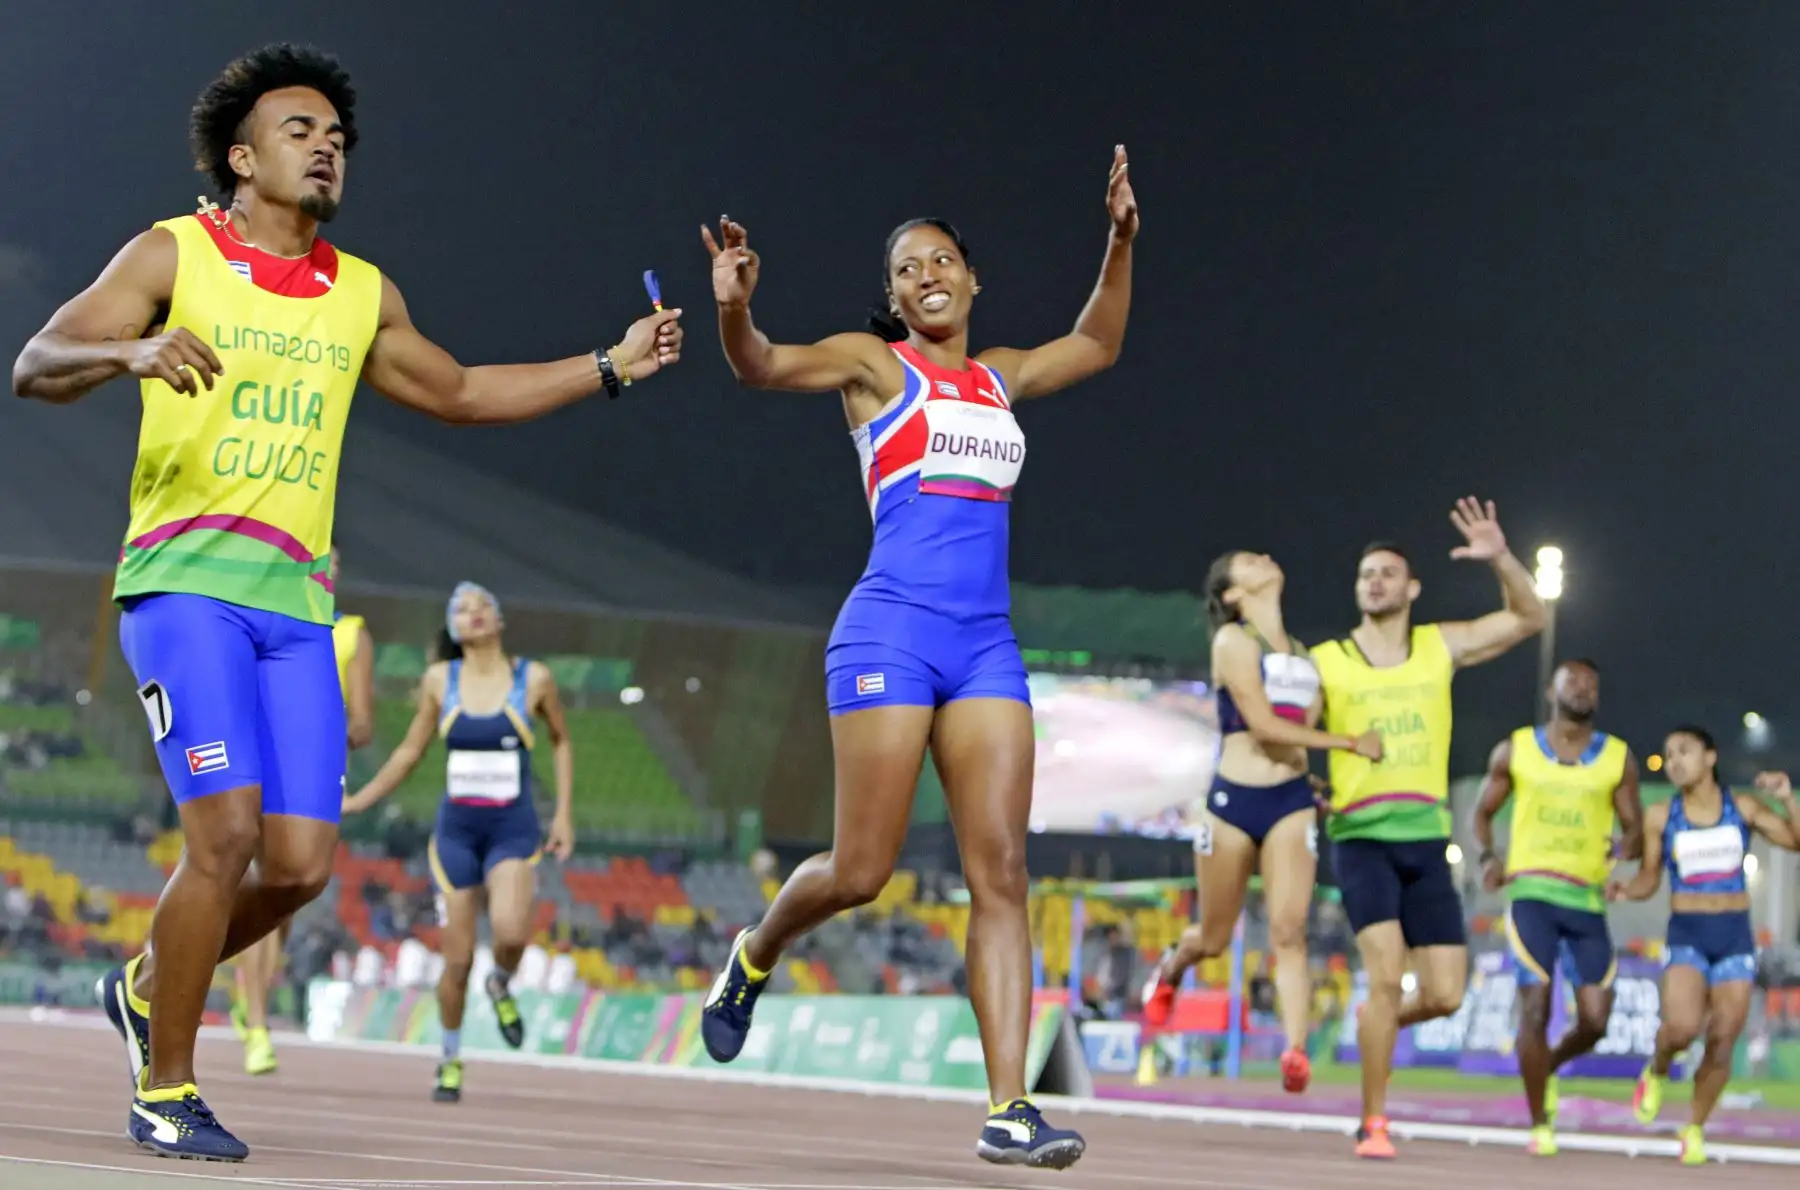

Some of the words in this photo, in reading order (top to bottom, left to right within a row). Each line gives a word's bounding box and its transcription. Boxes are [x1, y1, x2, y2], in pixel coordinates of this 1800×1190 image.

[231, 379, 324, 432] GUÍA
[212, 436, 327, 491] GUIDE
[931, 432, 1022, 464] DURAND
[142, 681, 167, 735] 7
